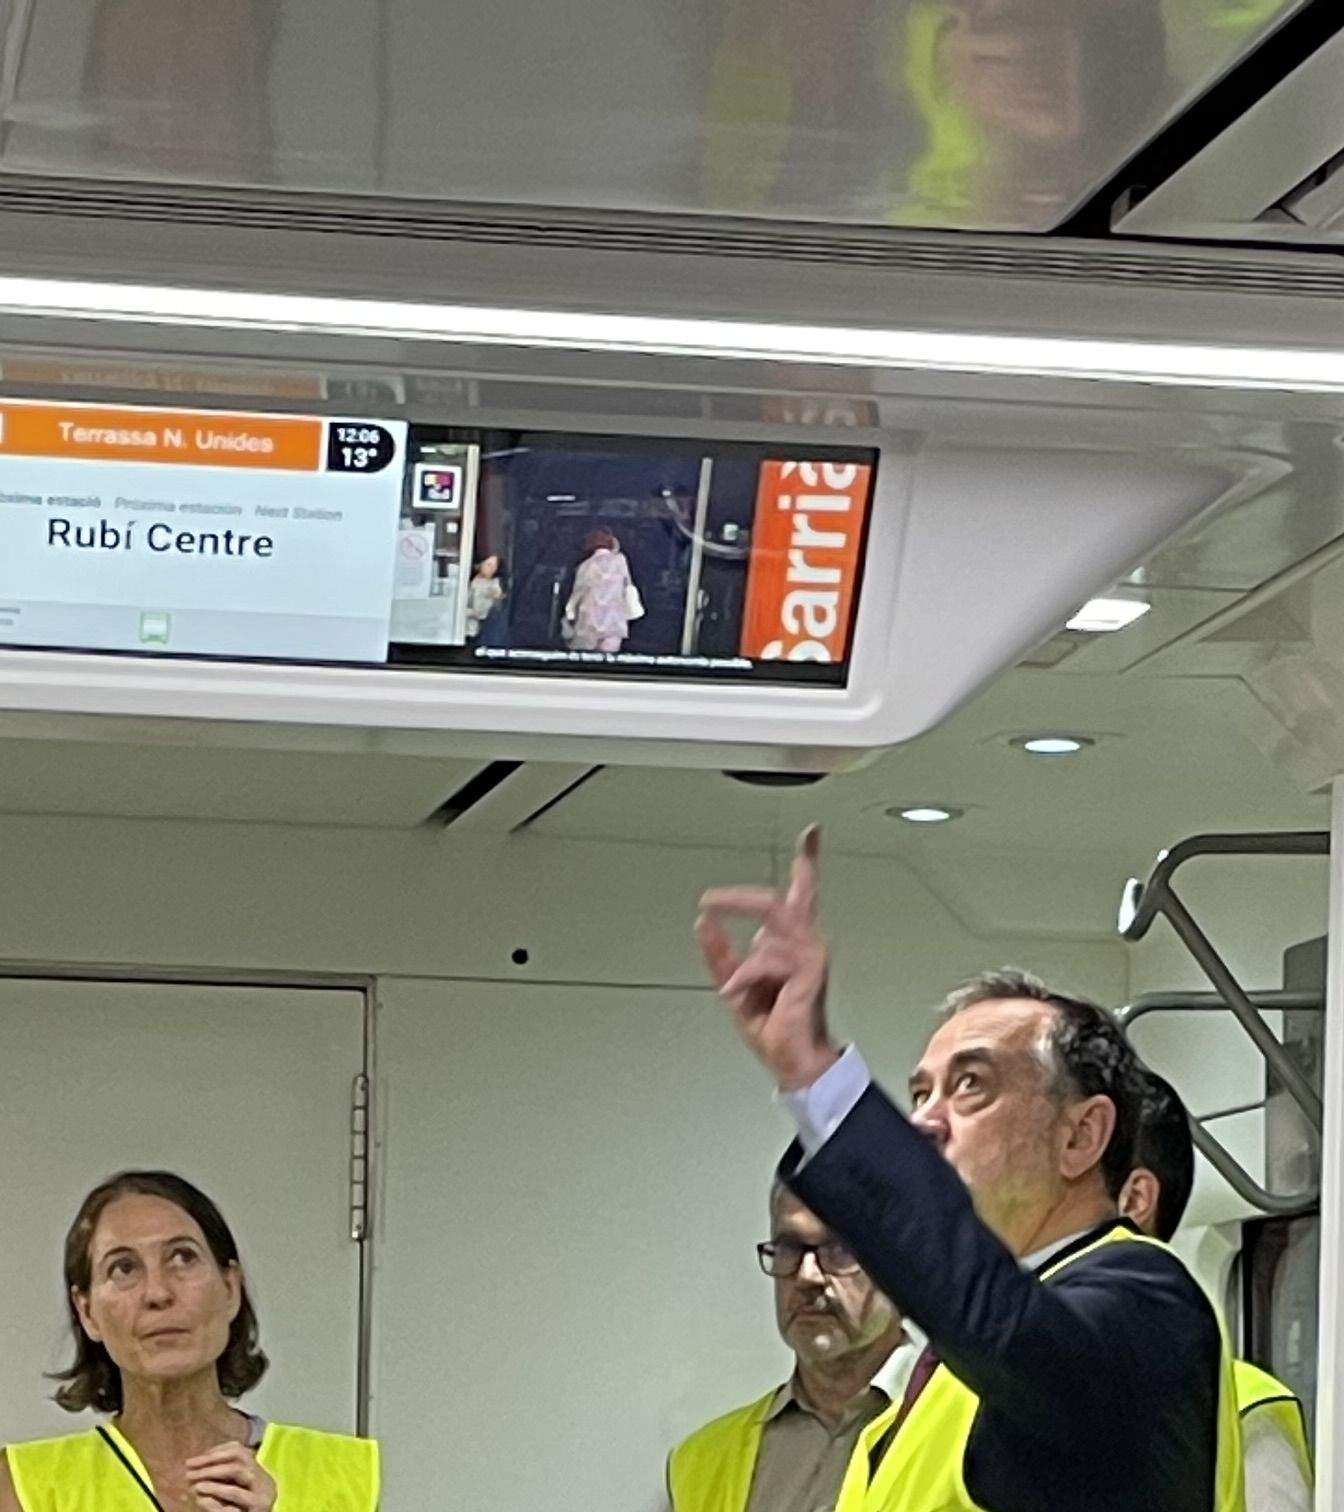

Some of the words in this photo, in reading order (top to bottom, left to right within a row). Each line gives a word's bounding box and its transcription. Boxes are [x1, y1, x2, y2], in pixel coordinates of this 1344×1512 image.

[59, 421, 157, 447] Terrassa
[163, 428, 187, 449] N.
[196, 430, 274, 453] Unides
[48, 518, 136, 550] Rubí
[147, 523, 273, 557] Centre
